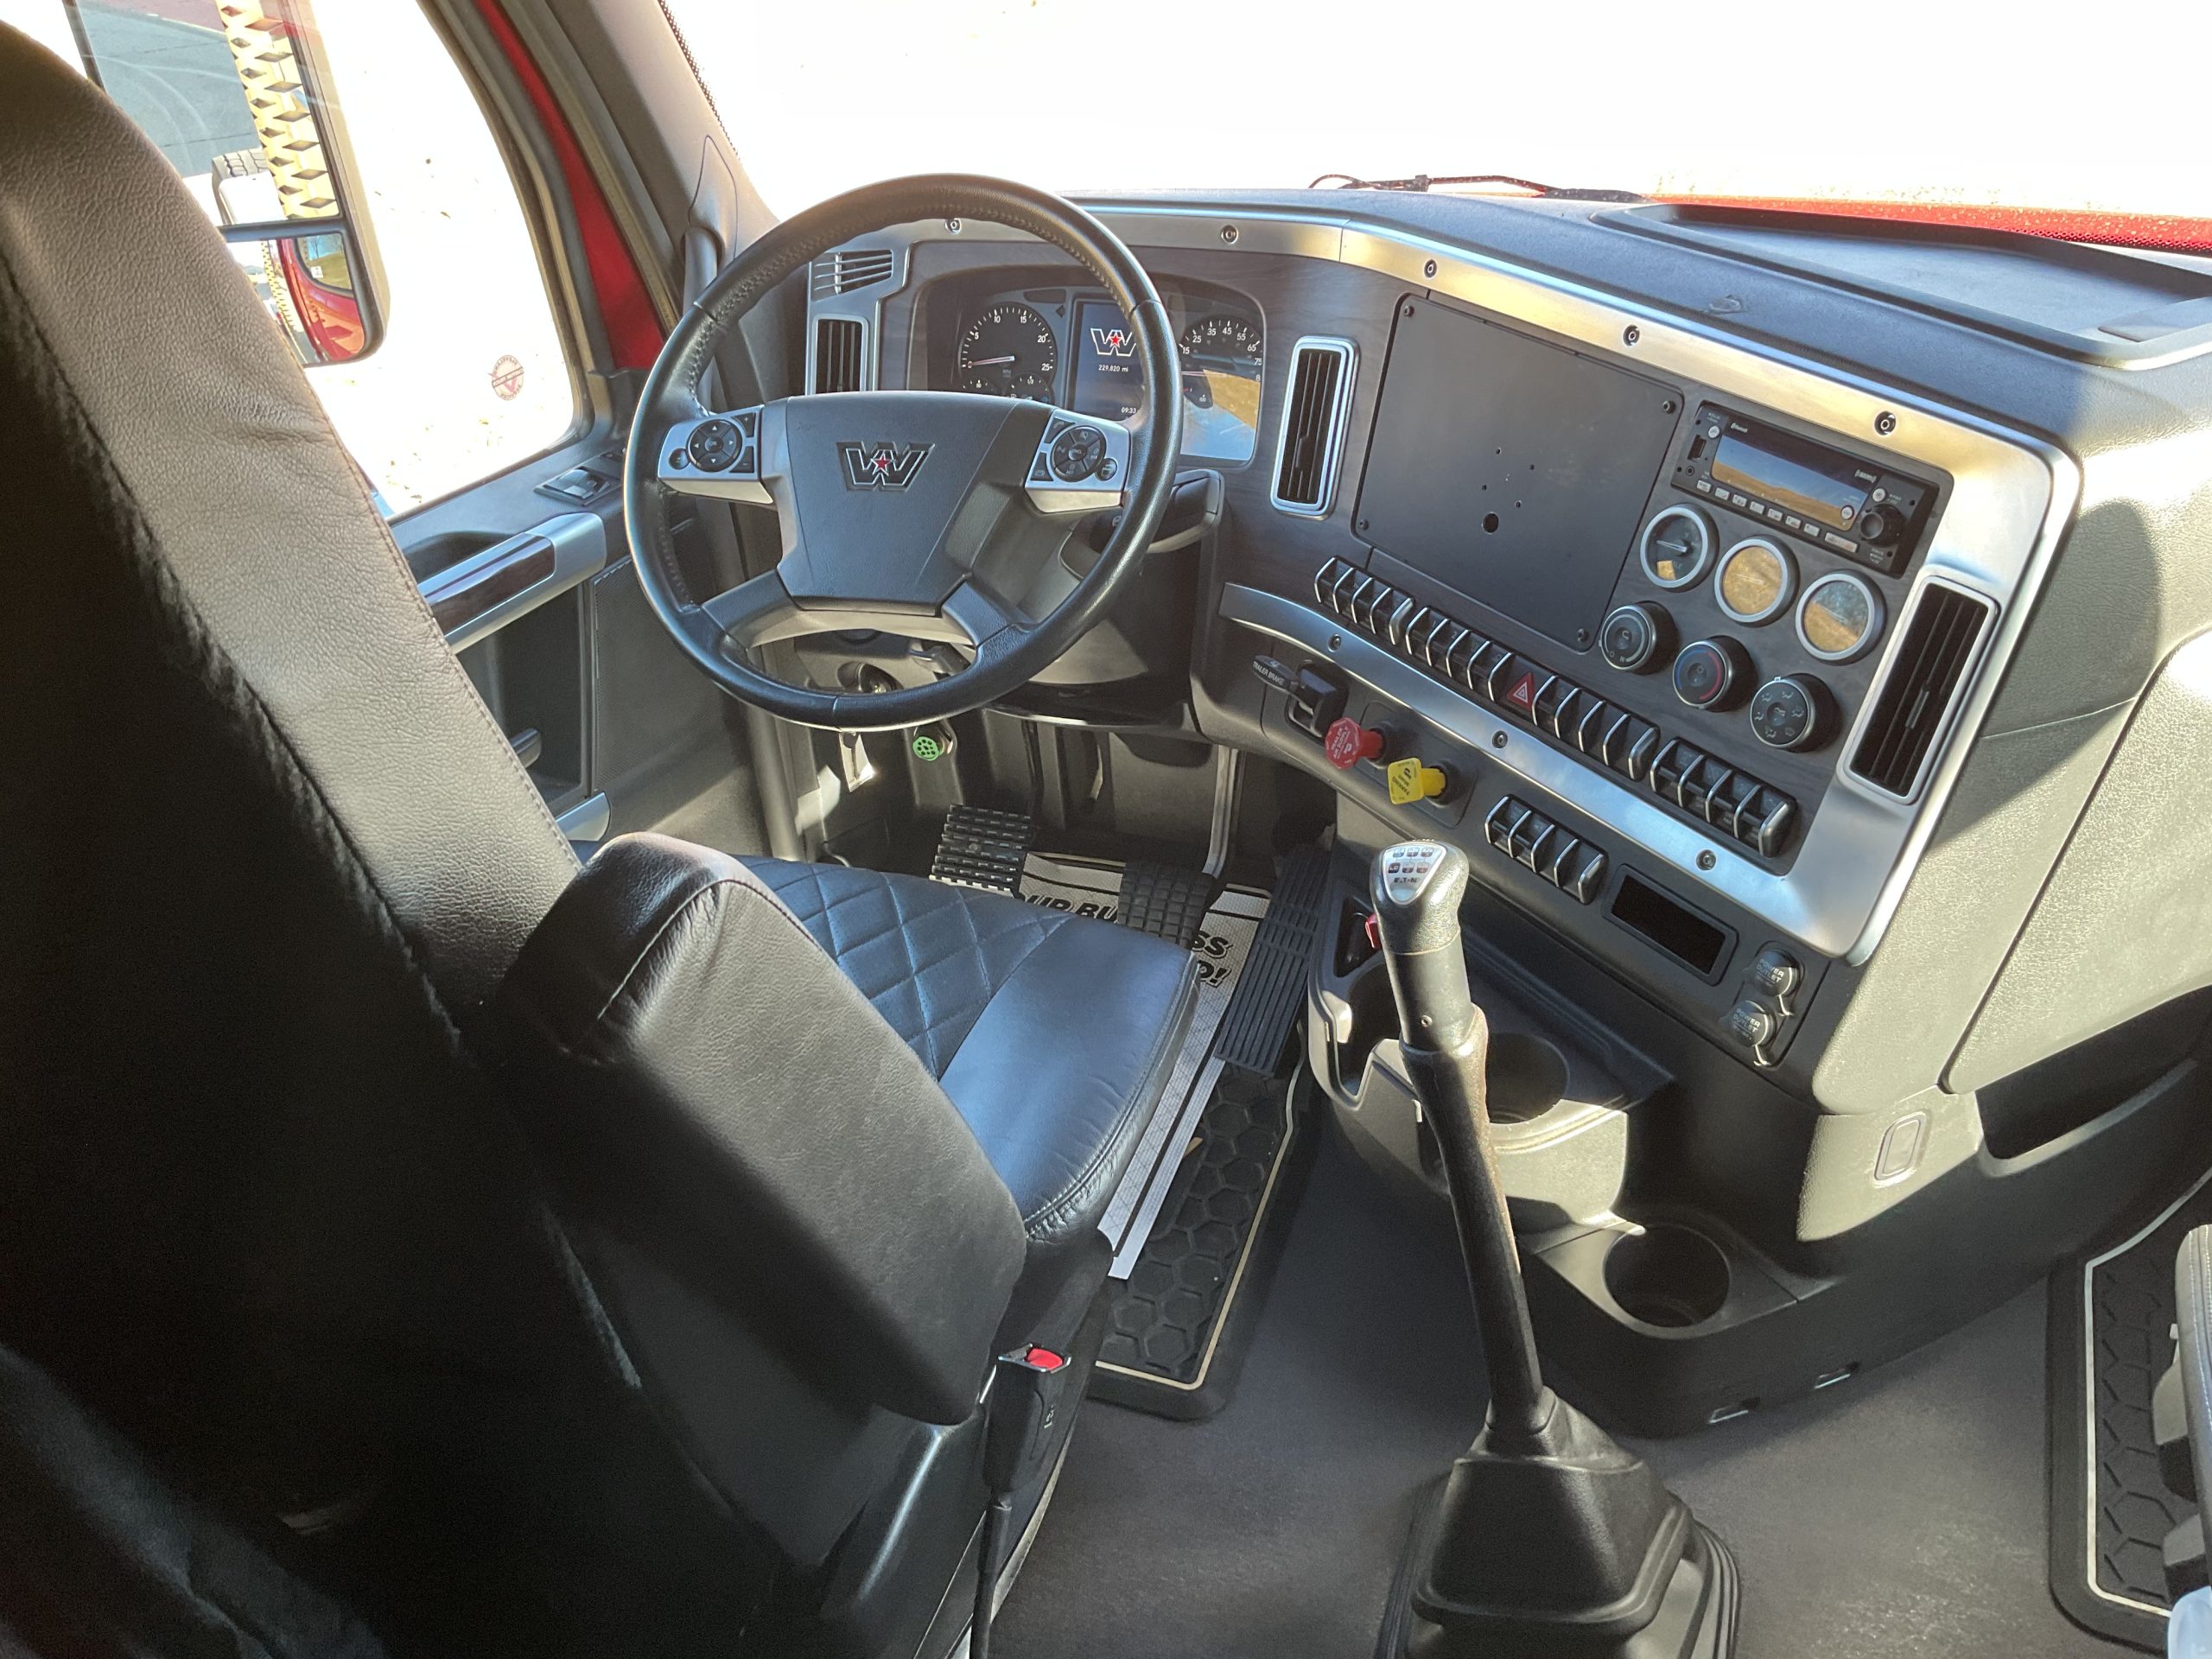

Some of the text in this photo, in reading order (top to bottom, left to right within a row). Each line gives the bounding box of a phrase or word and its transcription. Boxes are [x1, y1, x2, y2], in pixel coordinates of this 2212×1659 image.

[1252, 661, 1285, 685] TRAILER BRAKE
[1756, 963, 1782, 982] OUTLET
[1759, 958, 1784, 977] POWER
[1733, 1014, 1758, 1033] OUTLET
[1736, 1008, 1761, 1027] POWER
